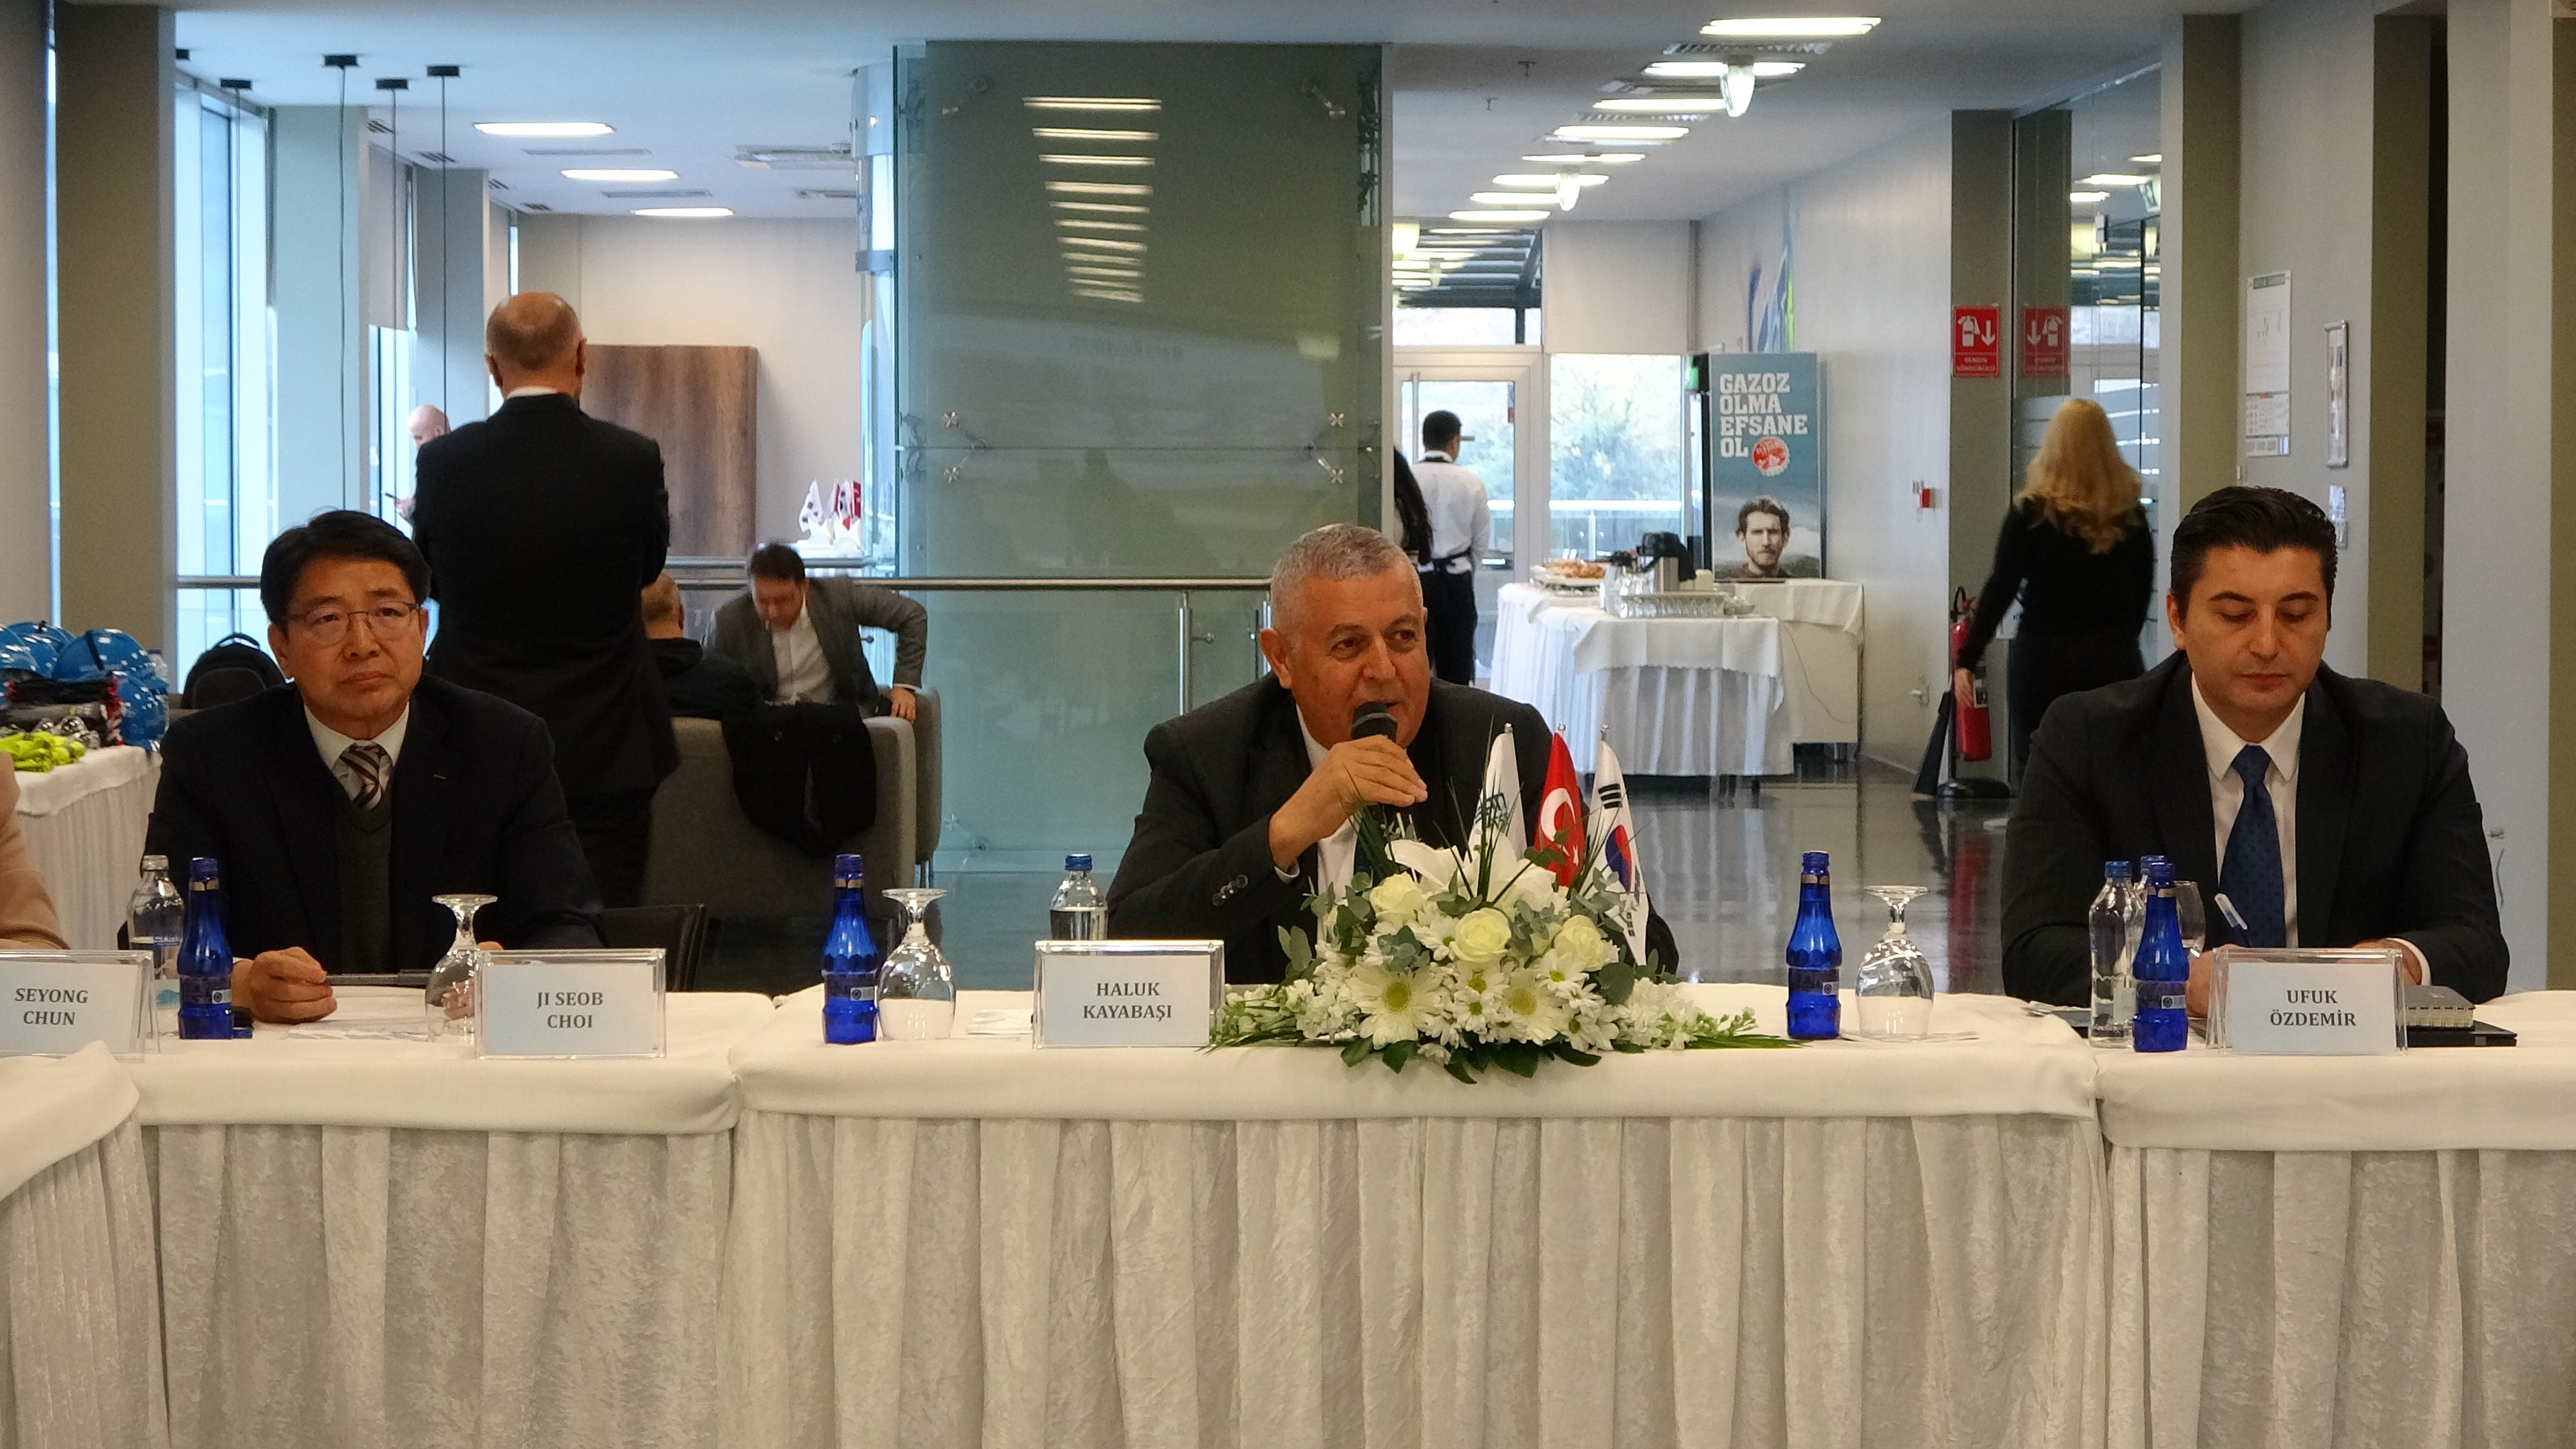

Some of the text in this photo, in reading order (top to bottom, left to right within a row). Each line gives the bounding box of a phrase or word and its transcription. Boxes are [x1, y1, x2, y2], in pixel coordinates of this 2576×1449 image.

[1719, 372, 1791, 394] GAZOZ
[1719, 394, 1782, 415] OLMA
[1720, 415, 1808, 436] EFSANE
[1720, 437, 1750, 458] OL
[14, 987, 88, 1004] SEYONG
[1096, 982, 1160, 997] HALUK
[2287, 989, 2338, 1004] UFUK
[537, 991, 603, 1010] JI SEOB
[23, 1010, 76, 1026] CHUN
[547, 1014, 593, 1029] CHOI
[1083, 1004, 1172, 1022] KAYABAŞI
[2269, 1008, 2357, 1026] ÖZDEMİR
